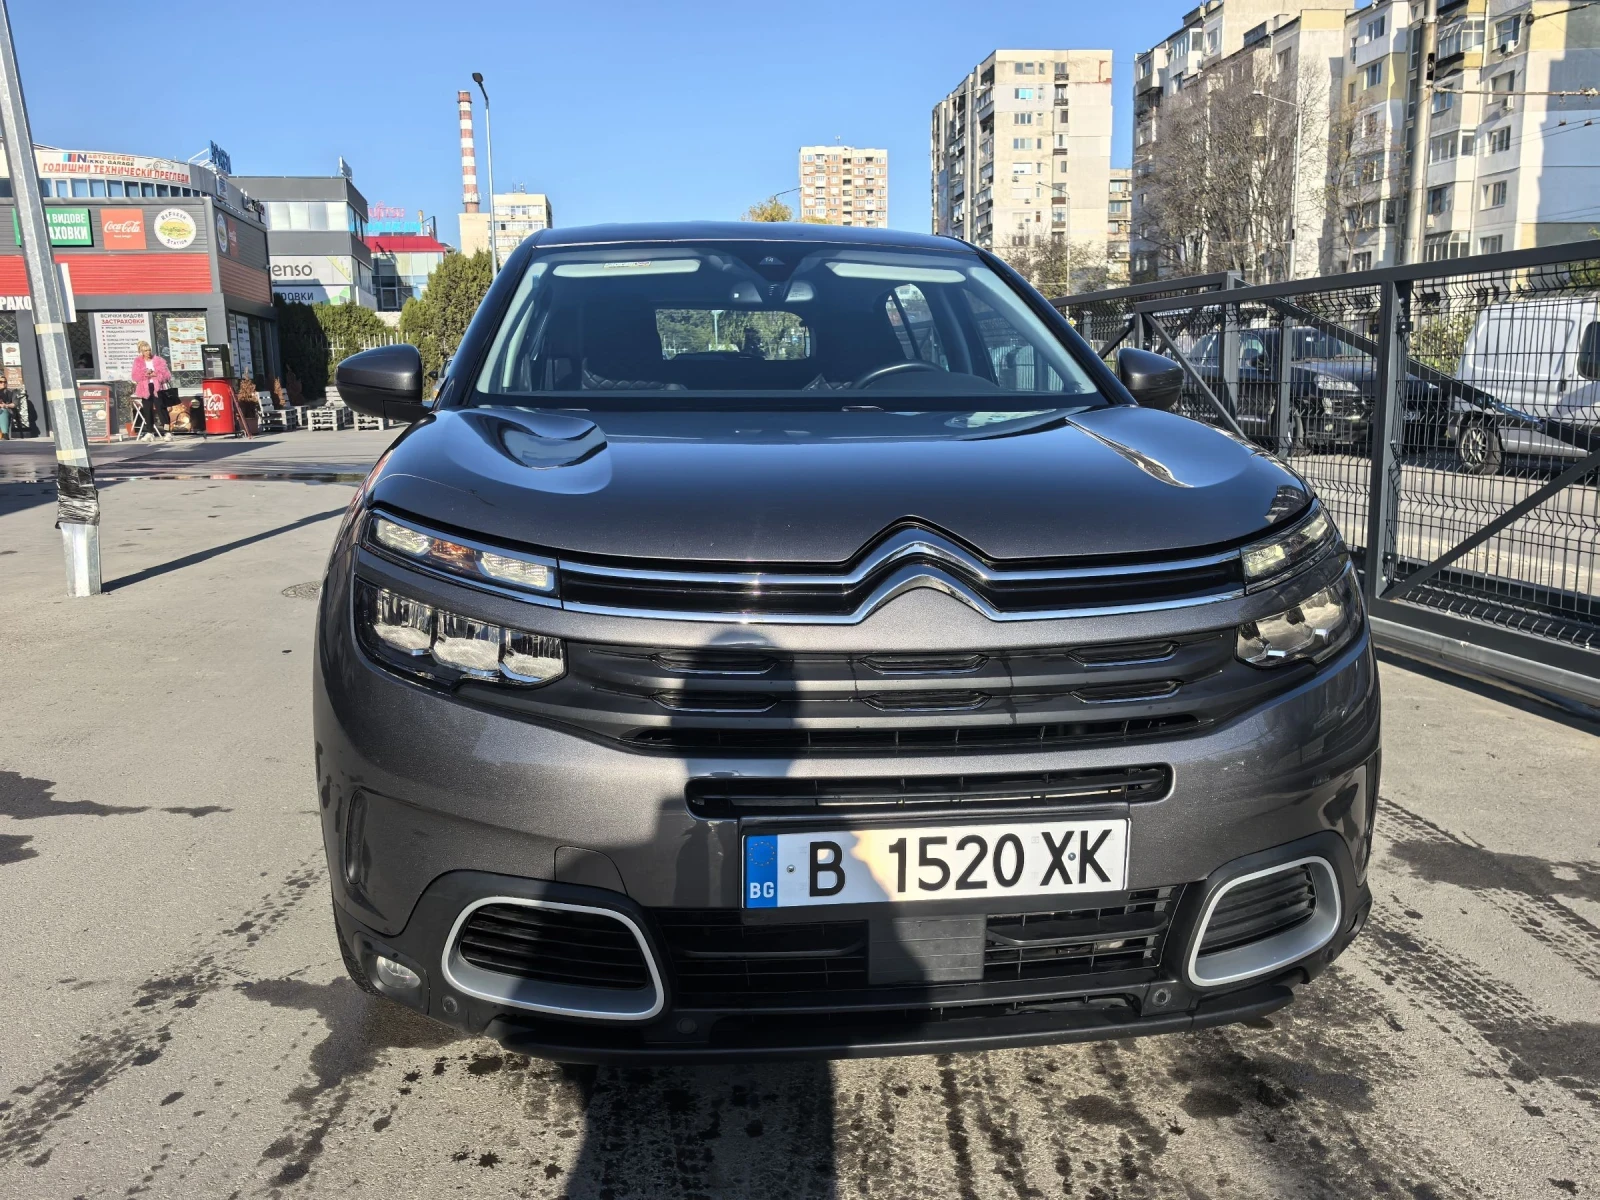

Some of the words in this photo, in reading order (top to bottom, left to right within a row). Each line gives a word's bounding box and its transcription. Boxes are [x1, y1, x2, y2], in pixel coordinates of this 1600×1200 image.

[87, 154, 135, 162] АВТОСЕРВИЗ
[43, 163, 91, 173] ГОДИШНИ
[94, 165, 152, 178] ТЕХНИЧЕСКИ
[154, 170, 190, 184] ПРЕГЛЕДИ
[52, 213, 86, 225] ВИДОВЕ
[49, 226, 89, 240] АХОВКИ
[103, 220, 141, 233] Coca-Cola
[0, 296, 33, 311] РАХО
[809, 840, 846, 897] B
[888, 833, 1025, 893] 1520
[1040, 828, 1113, 887] XK
[749, 881, 774, 899] BG
